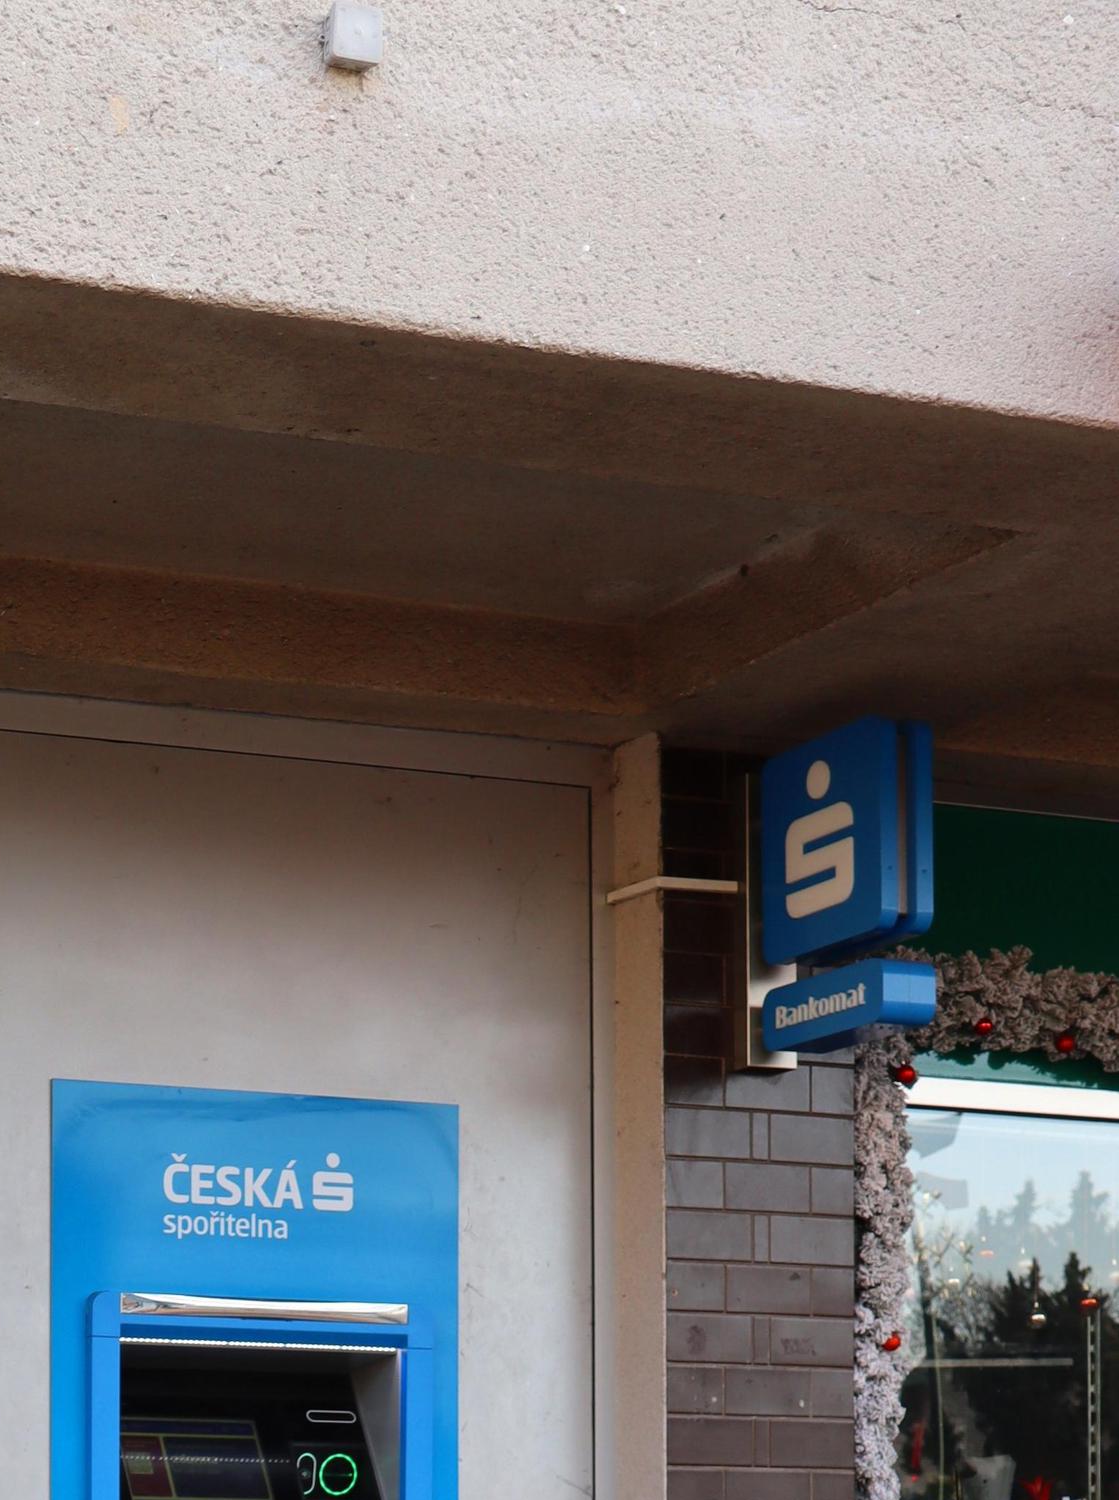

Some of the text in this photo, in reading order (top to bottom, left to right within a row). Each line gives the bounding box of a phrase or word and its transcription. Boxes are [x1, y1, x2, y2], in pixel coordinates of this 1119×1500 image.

[775, 982, 867, 1030] Bankomat
[163, 1152, 304, 1210] ČESKÁ
[162, 1210, 289, 1240] spořitelna
